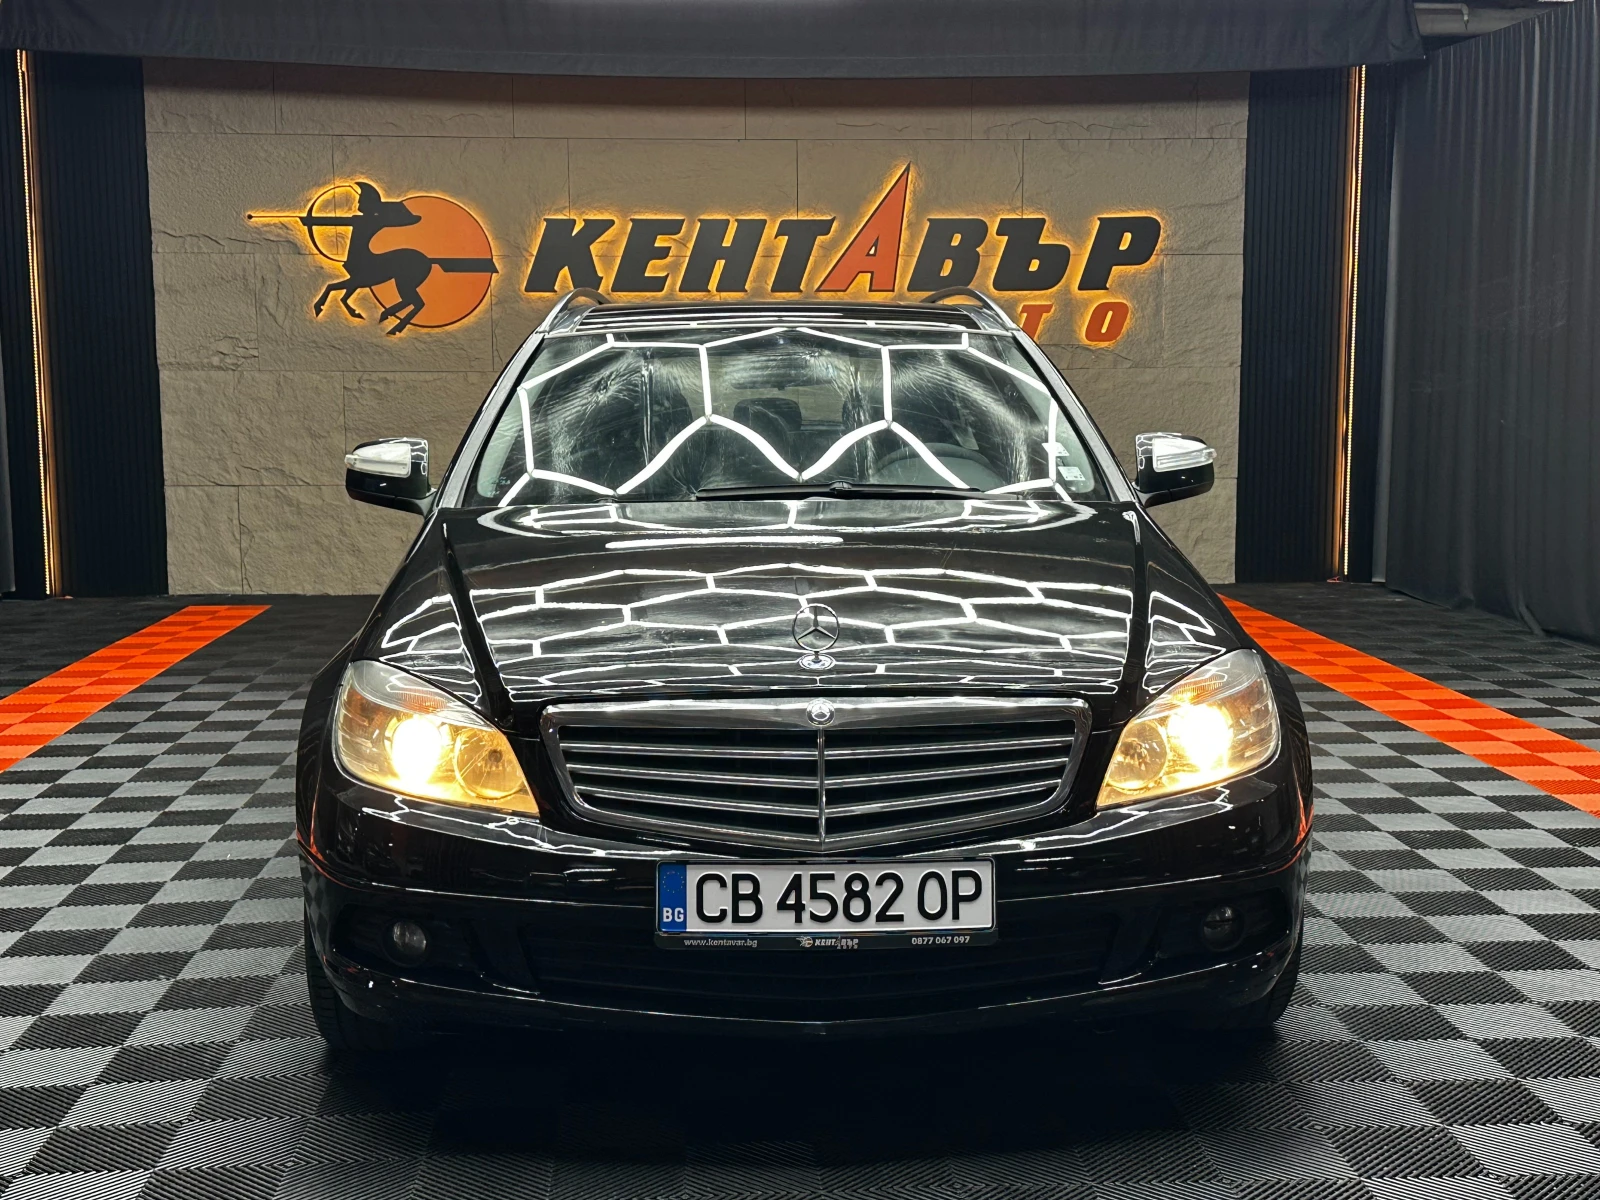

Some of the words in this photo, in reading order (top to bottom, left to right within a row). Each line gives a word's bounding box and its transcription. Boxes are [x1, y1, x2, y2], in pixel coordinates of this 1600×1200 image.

[524, 161, 1161, 292] КЕНТАВЪР
[1018, 301, 1130, 342] ТО
[695, 872, 763, 924] CB
[776, 871, 905, 924] 4582
[917, 868, 983, 921] OP
[662, 907, 684, 922] BG
[683, 938, 758, 948] www.kentavar.bg
[911, 937, 934, 945] 0877
[935, 936, 952, 944] 067
[953, 935, 970, 943] 097
